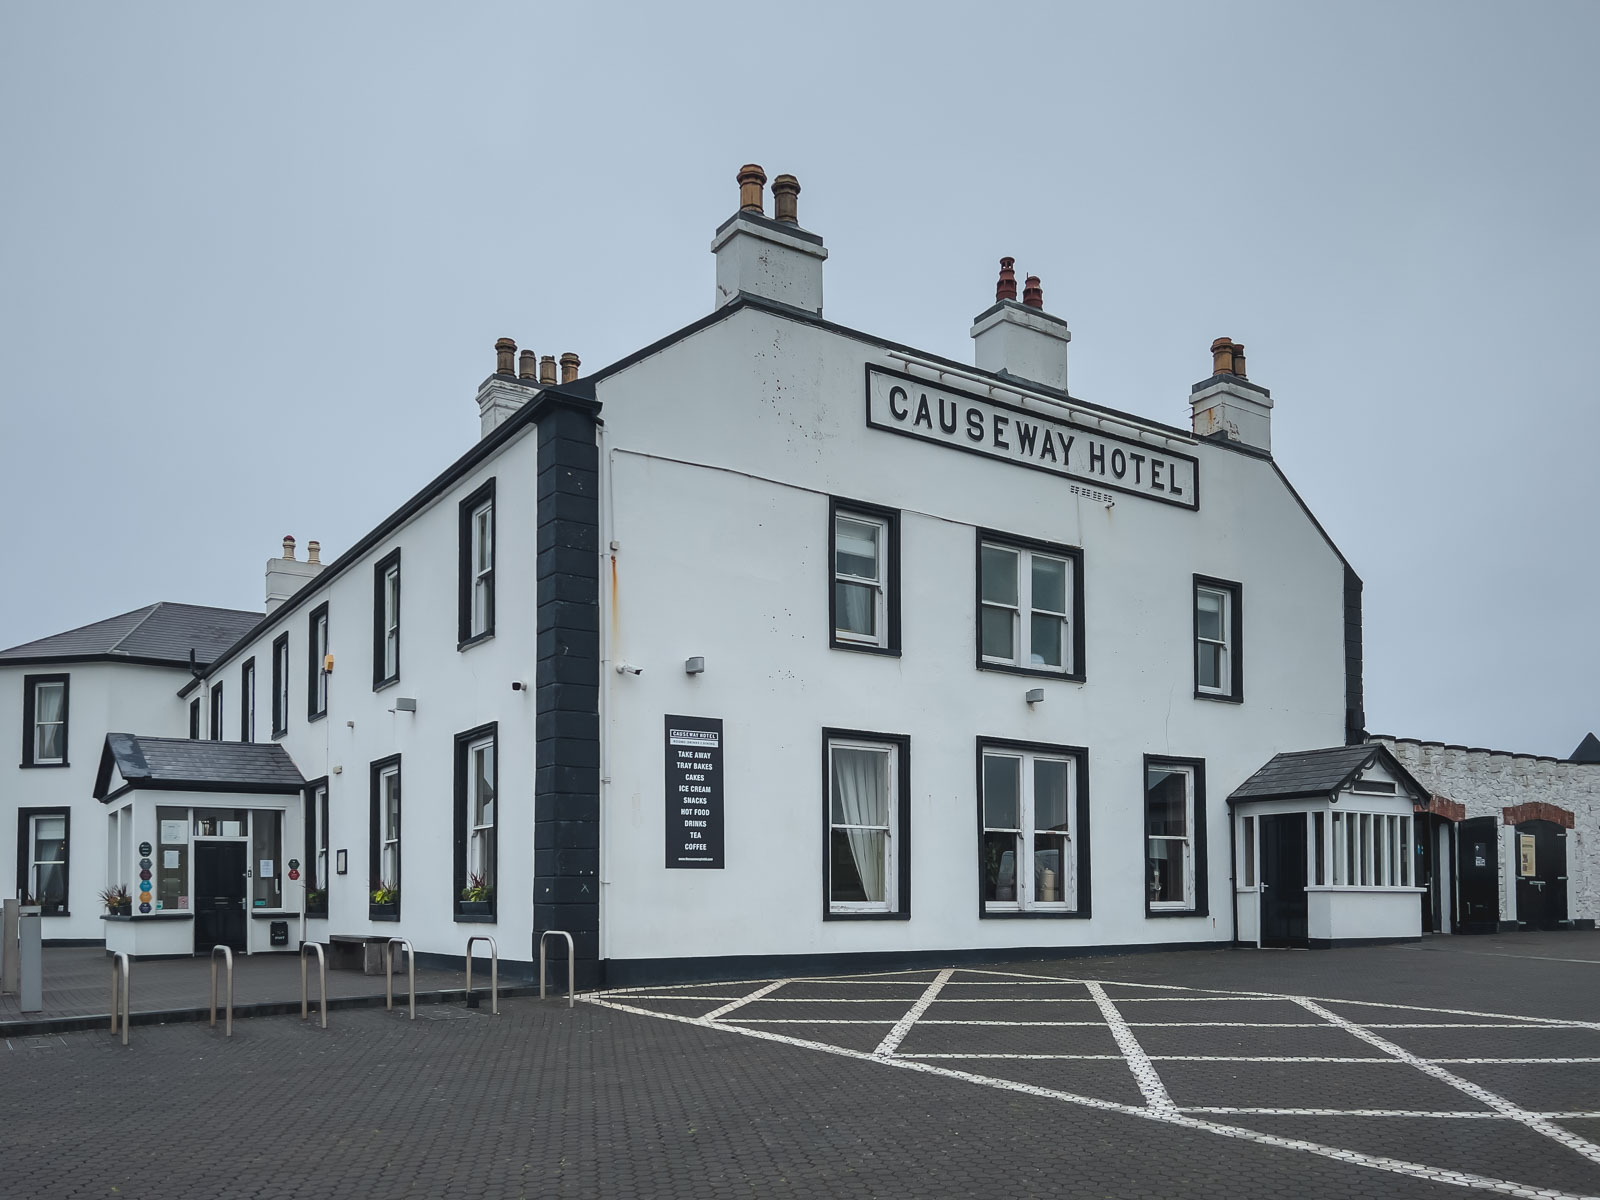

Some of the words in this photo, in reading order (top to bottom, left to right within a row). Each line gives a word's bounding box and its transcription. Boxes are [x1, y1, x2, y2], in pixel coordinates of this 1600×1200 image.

[888, 385, 1075, 466] CAUSEWAY
[1088, 440, 1183, 496] HOTEL
[677, 750, 693, 758] TAKE
[694, 751, 712, 759] AWAY
[676, 761, 692, 769] TRAY
[693, 762, 713, 770] BAKES
[678, 784, 689, 792] ICE
[690, 785, 711, 793] CREAM
[683, 796, 707, 805] SNACKS
[694, 808, 710, 816] FOOD
[689, 831, 702, 839] TEA
[684, 843, 707, 851] COFFEE
